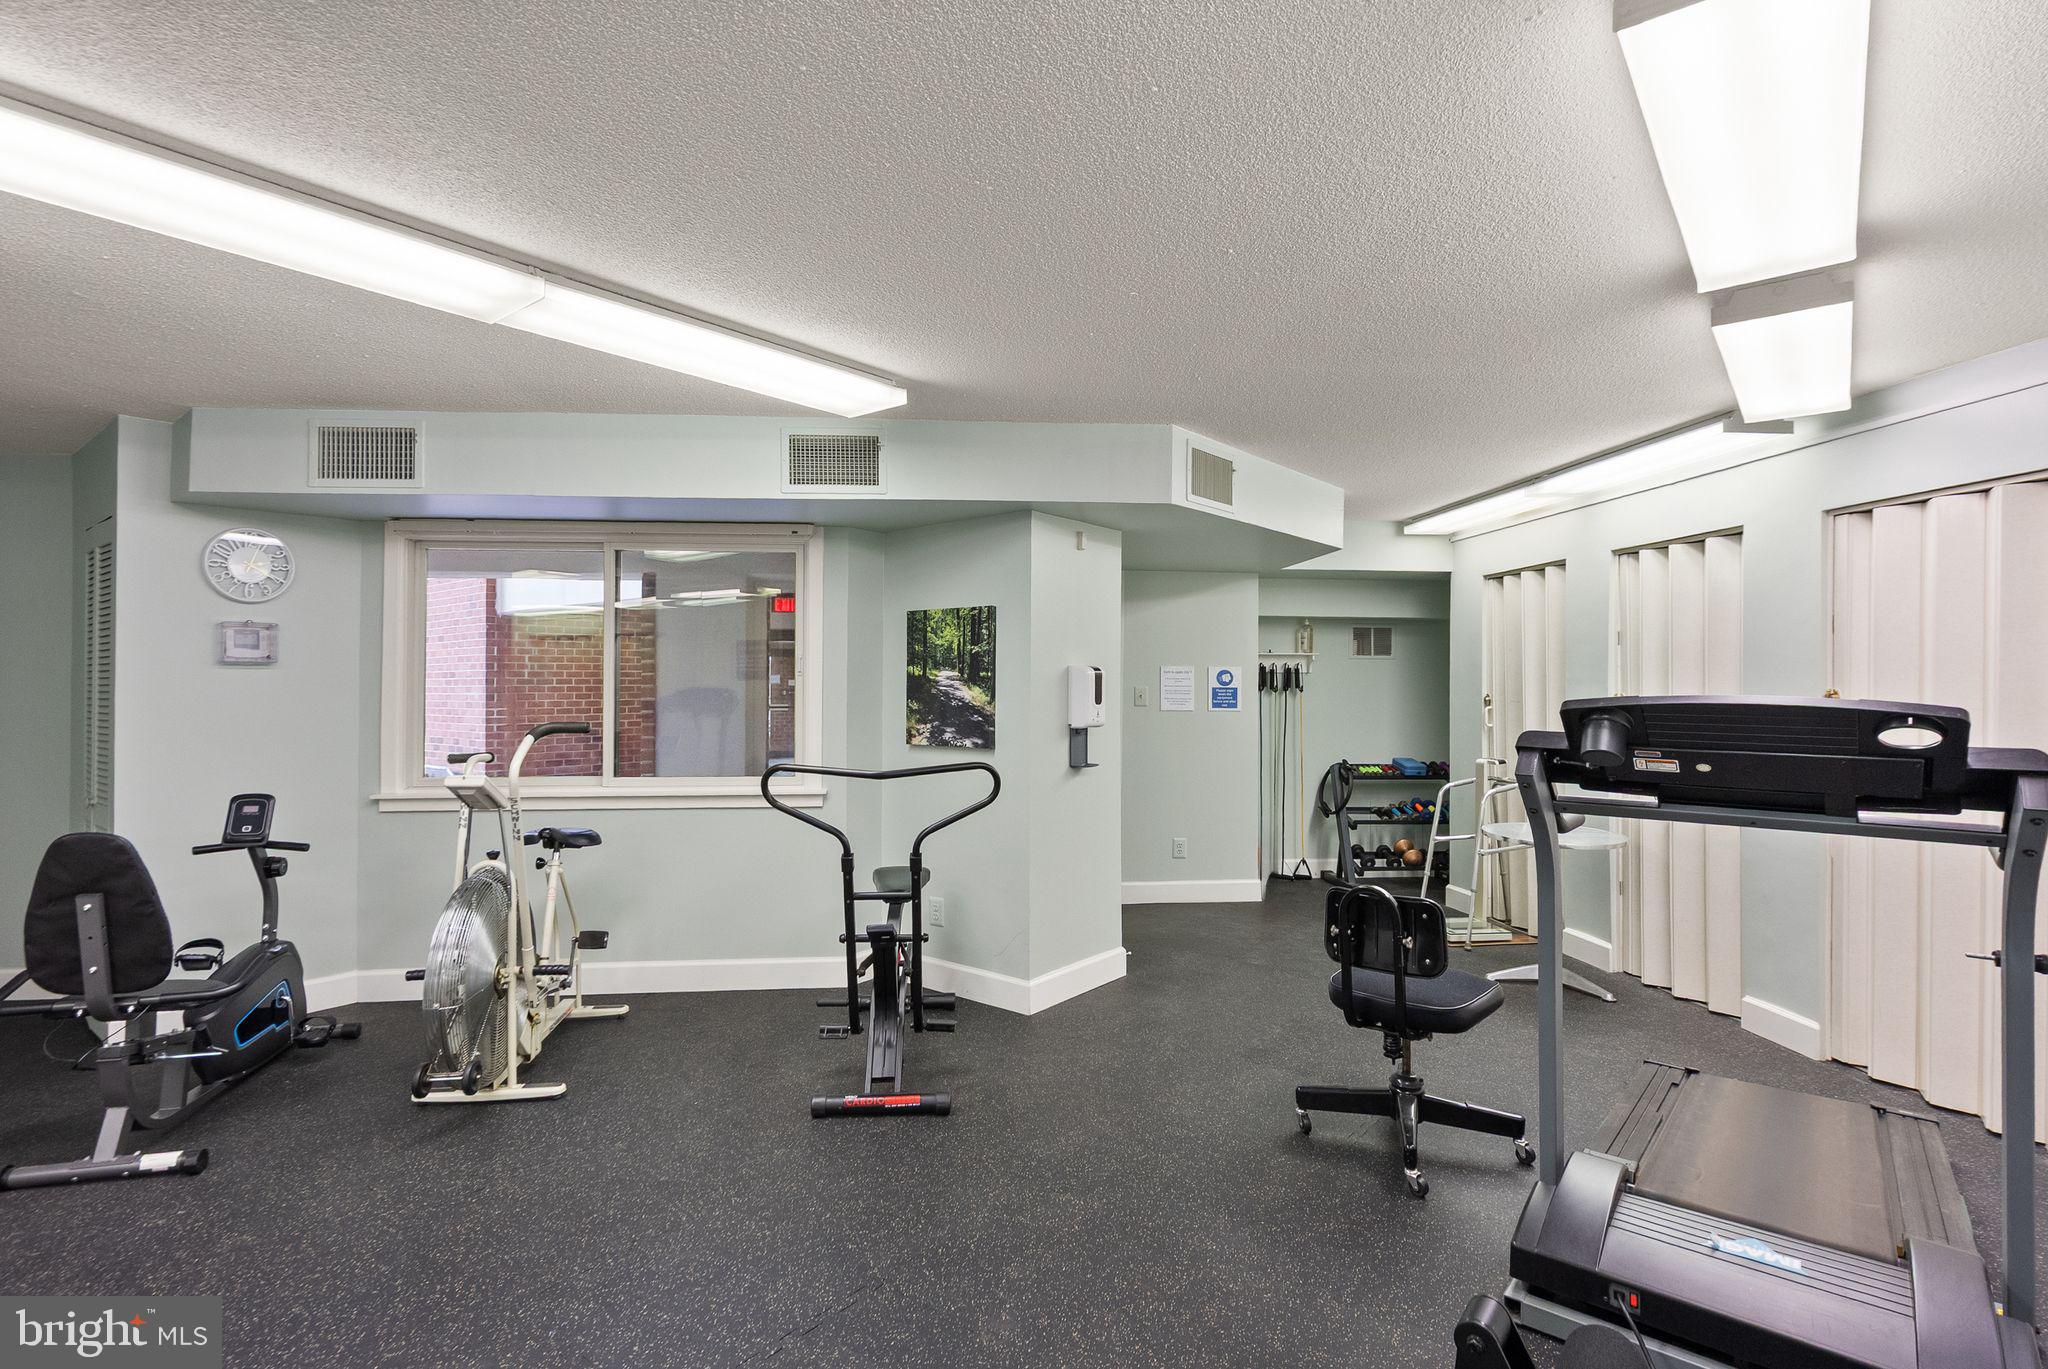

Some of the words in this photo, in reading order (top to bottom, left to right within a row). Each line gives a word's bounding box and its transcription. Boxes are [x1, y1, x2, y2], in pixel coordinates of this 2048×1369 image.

[271, 562, 289, 571] 3
[213, 571, 231, 581] 8
[245, 583, 255, 598] 6
[774, 597, 795, 612] EXIT
[845, 1096, 885, 1106] CARDIO
